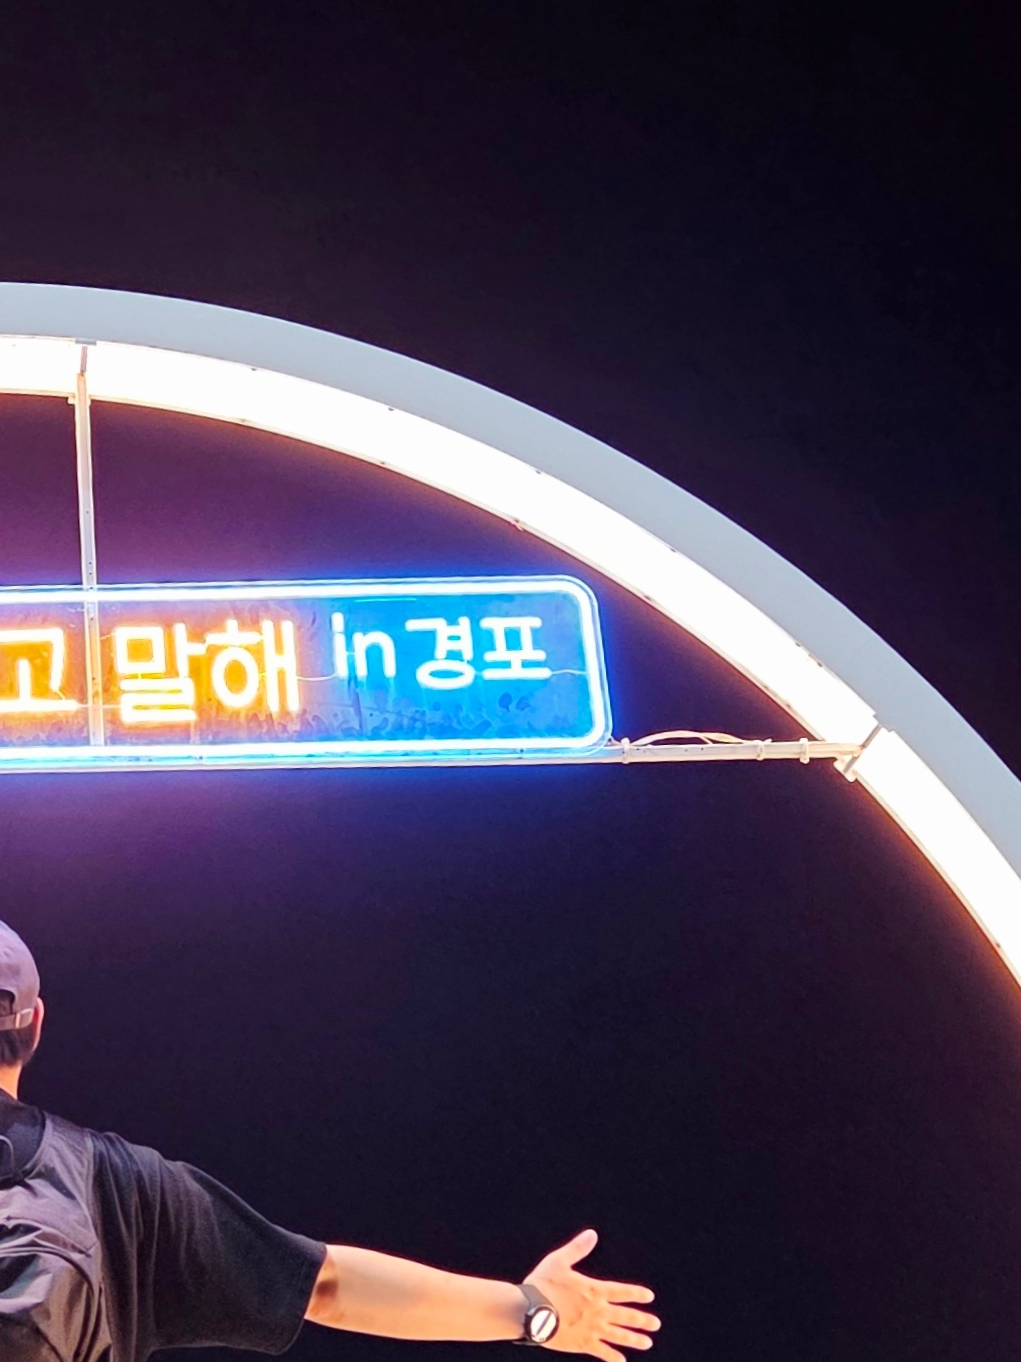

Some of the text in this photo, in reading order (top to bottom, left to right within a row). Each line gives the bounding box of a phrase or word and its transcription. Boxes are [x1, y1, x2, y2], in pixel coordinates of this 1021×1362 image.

[111, 618, 300, 724] 말해
[330, 611, 397, 679] in
[405, 615, 553, 690] 경포
